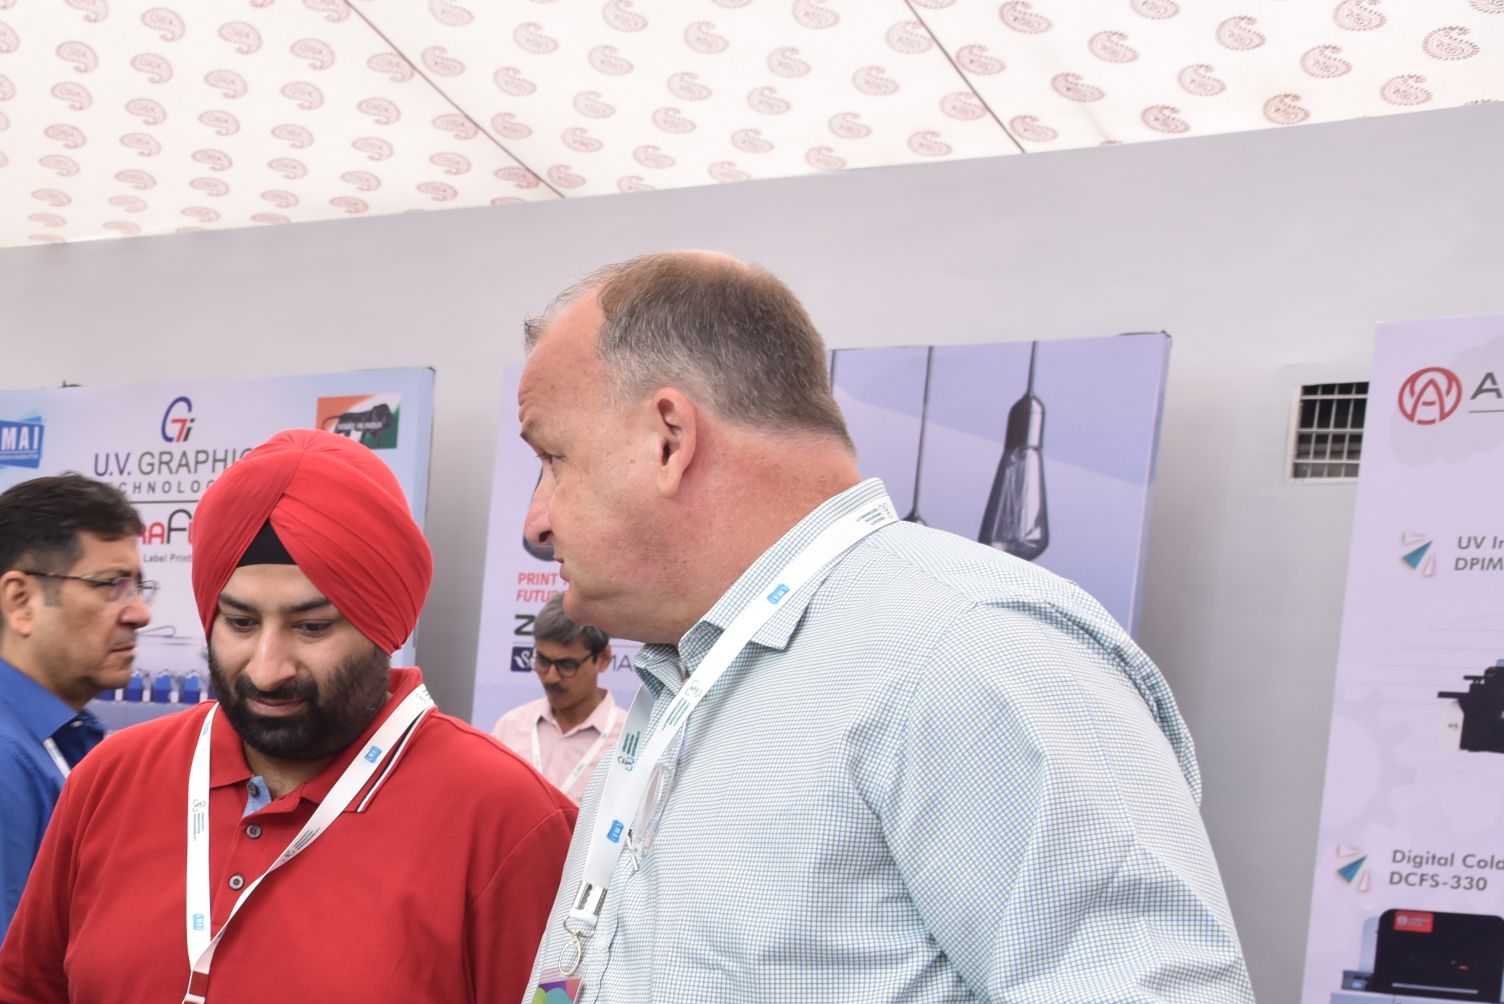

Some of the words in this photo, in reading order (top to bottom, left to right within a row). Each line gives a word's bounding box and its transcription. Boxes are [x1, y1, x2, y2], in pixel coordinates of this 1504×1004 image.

[94, 452, 132, 477] U.V.
[1457, 535, 1487, 550] UV
[143, 554, 167, 563] Label
[518, 572, 558, 585] PRINT
[1392, 849, 1455, 869] Digital
[1389, 871, 1488, 891] DCFS-330
